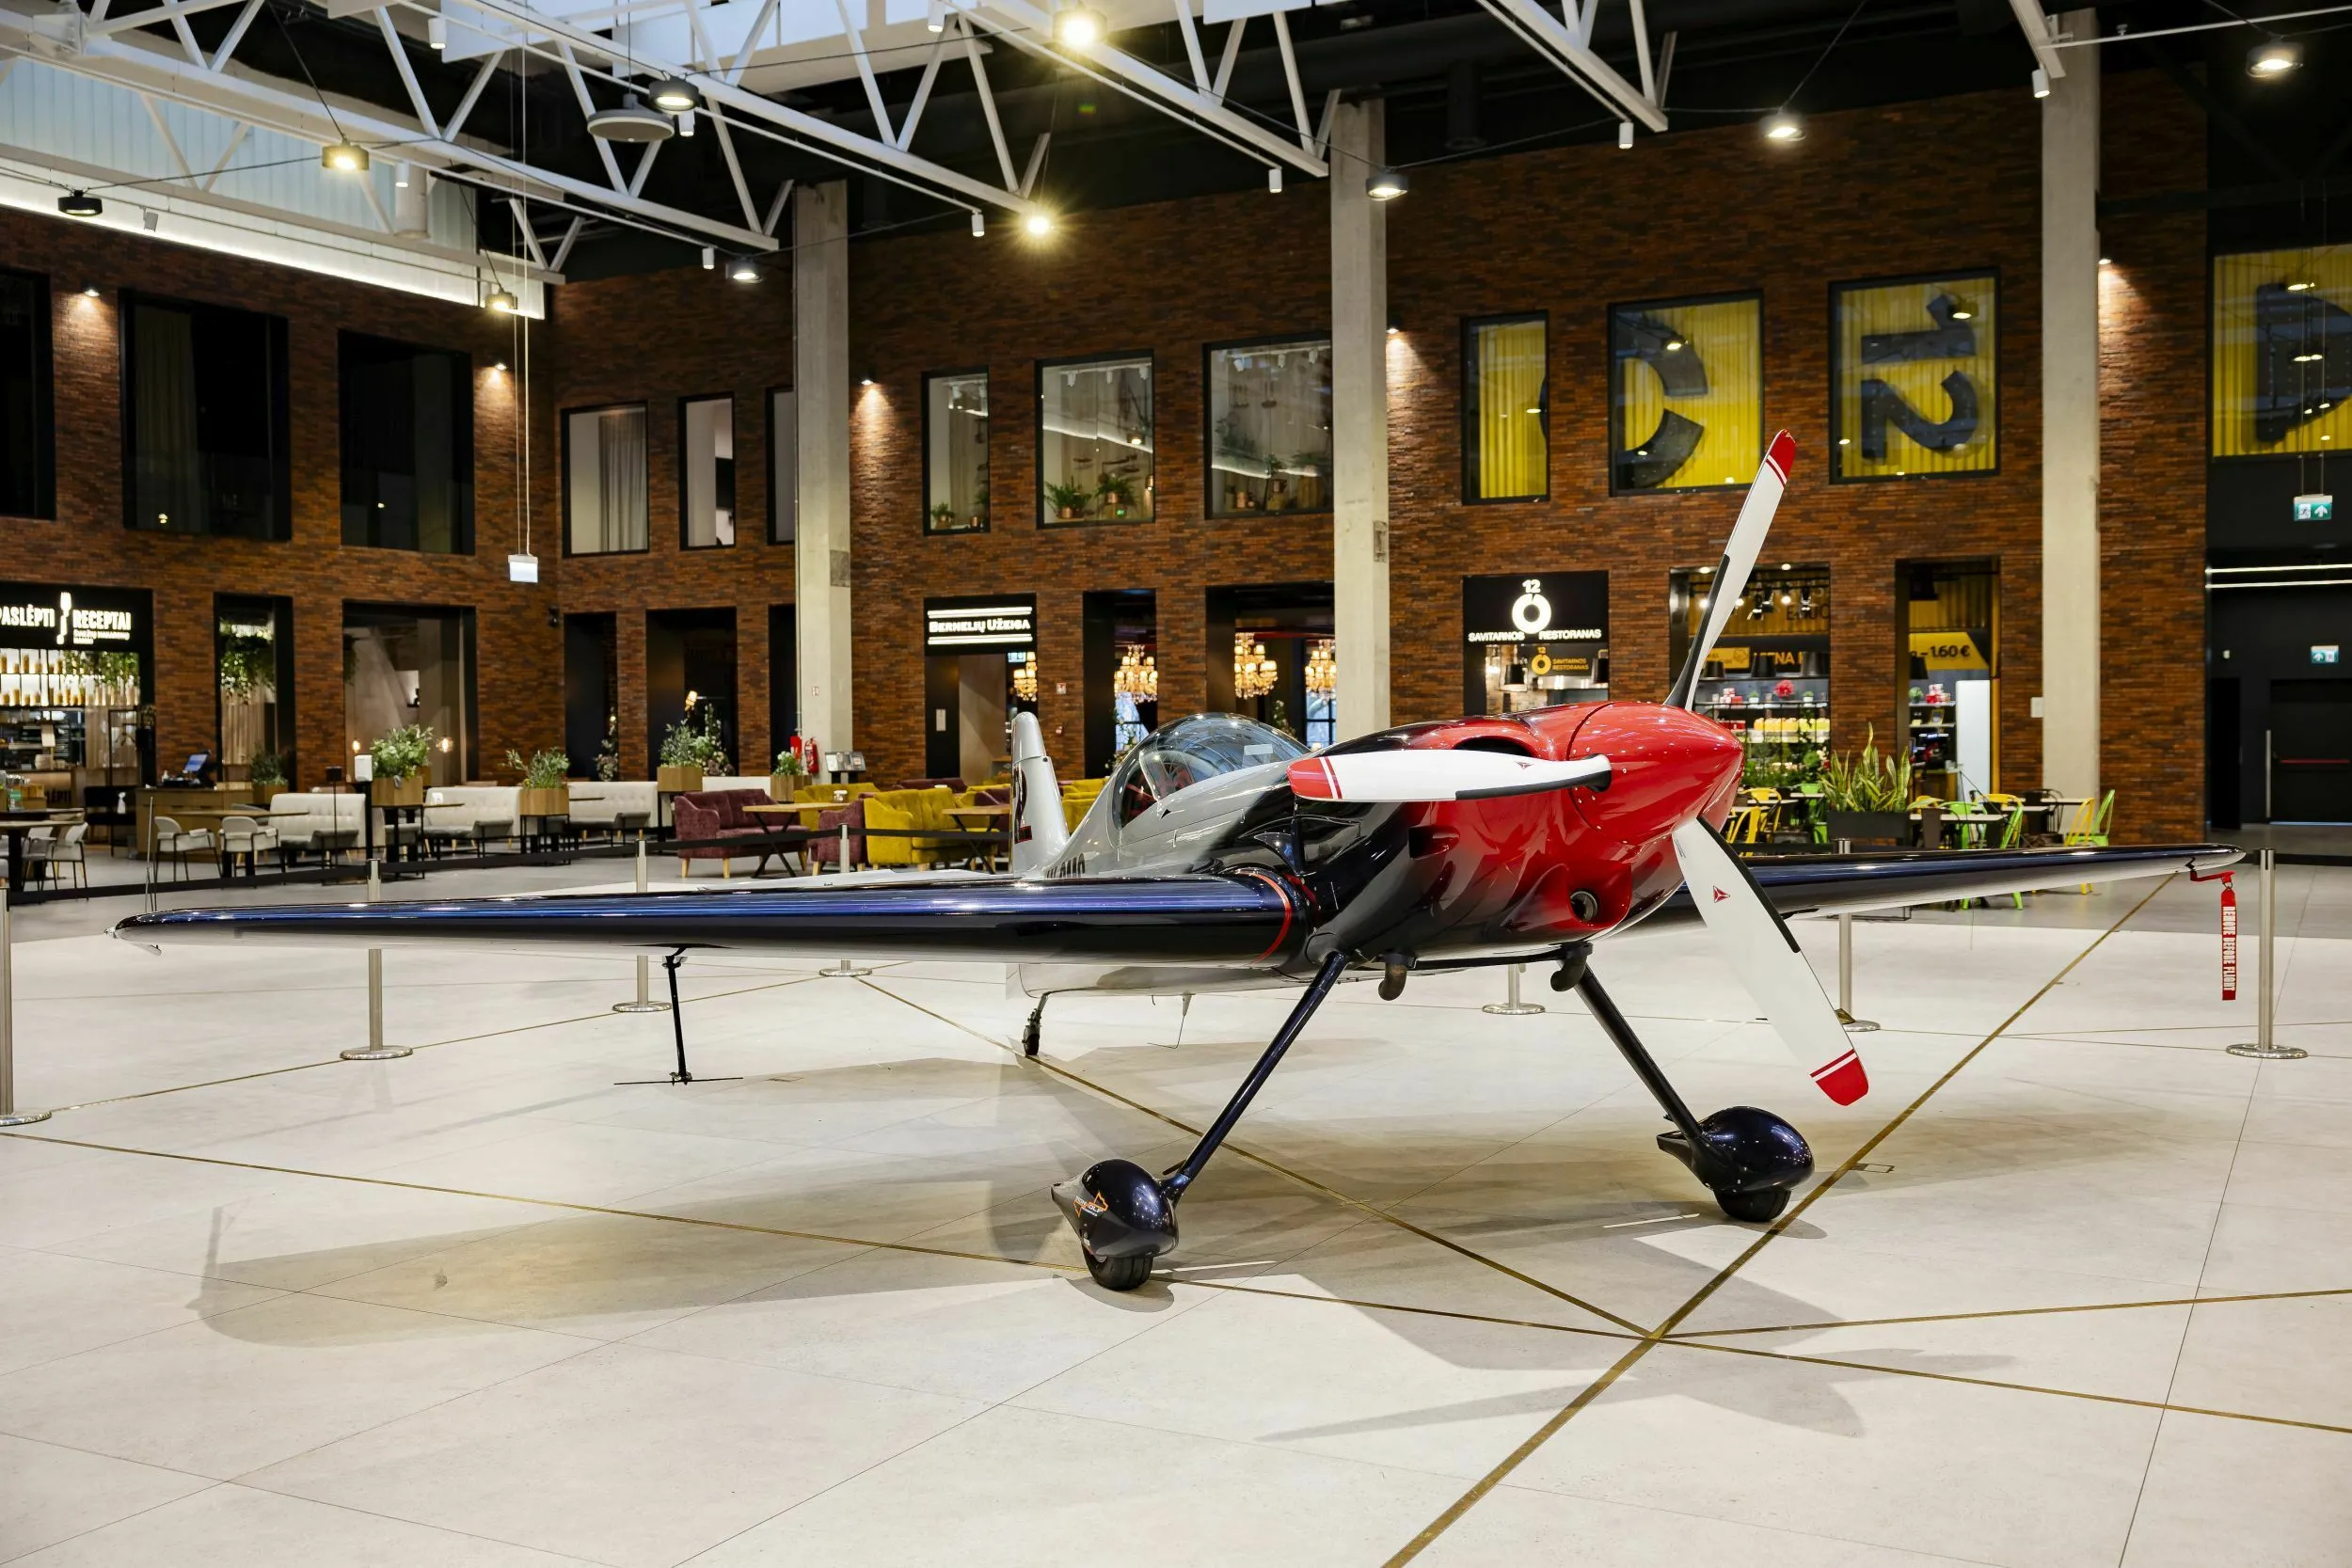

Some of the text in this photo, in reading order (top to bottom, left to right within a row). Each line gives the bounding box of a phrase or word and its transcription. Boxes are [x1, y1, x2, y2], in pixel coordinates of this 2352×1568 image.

[1522, 578, 1541, 594] 12
[72, 610, 132, 630] RECEPTAI
[1468, 628, 1602, 642] SAVITARNOS RESTORANAS
[2222, 906, 2236, 990] REMOVE BEFORE FLIGHT
